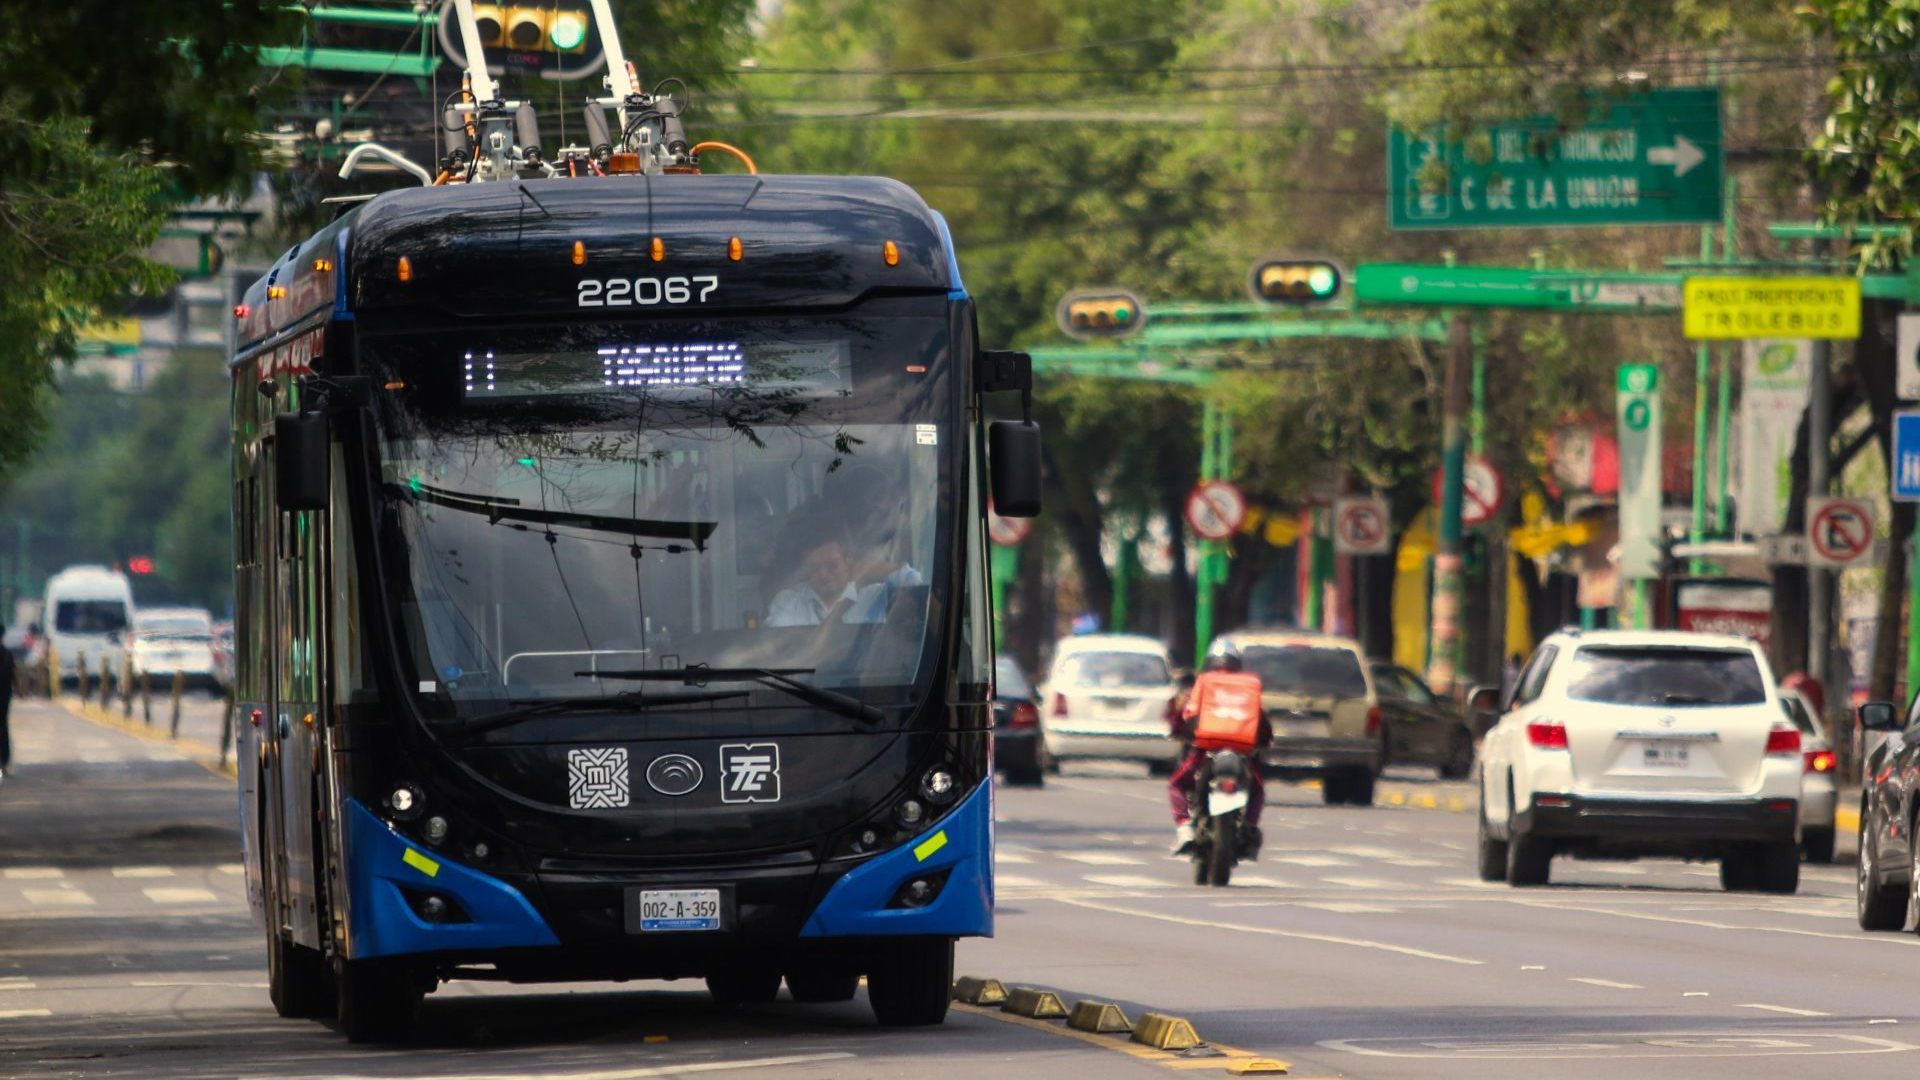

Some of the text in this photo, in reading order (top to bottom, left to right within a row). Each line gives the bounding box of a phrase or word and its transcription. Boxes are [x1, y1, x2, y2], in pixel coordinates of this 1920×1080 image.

[1526, 176, 1557, 210] LA
[577, 274, 718, 306] 22067
[1704, 312, 1844, 331] TROLEBUS
[643, 901, 717, 919] 002-A-359
